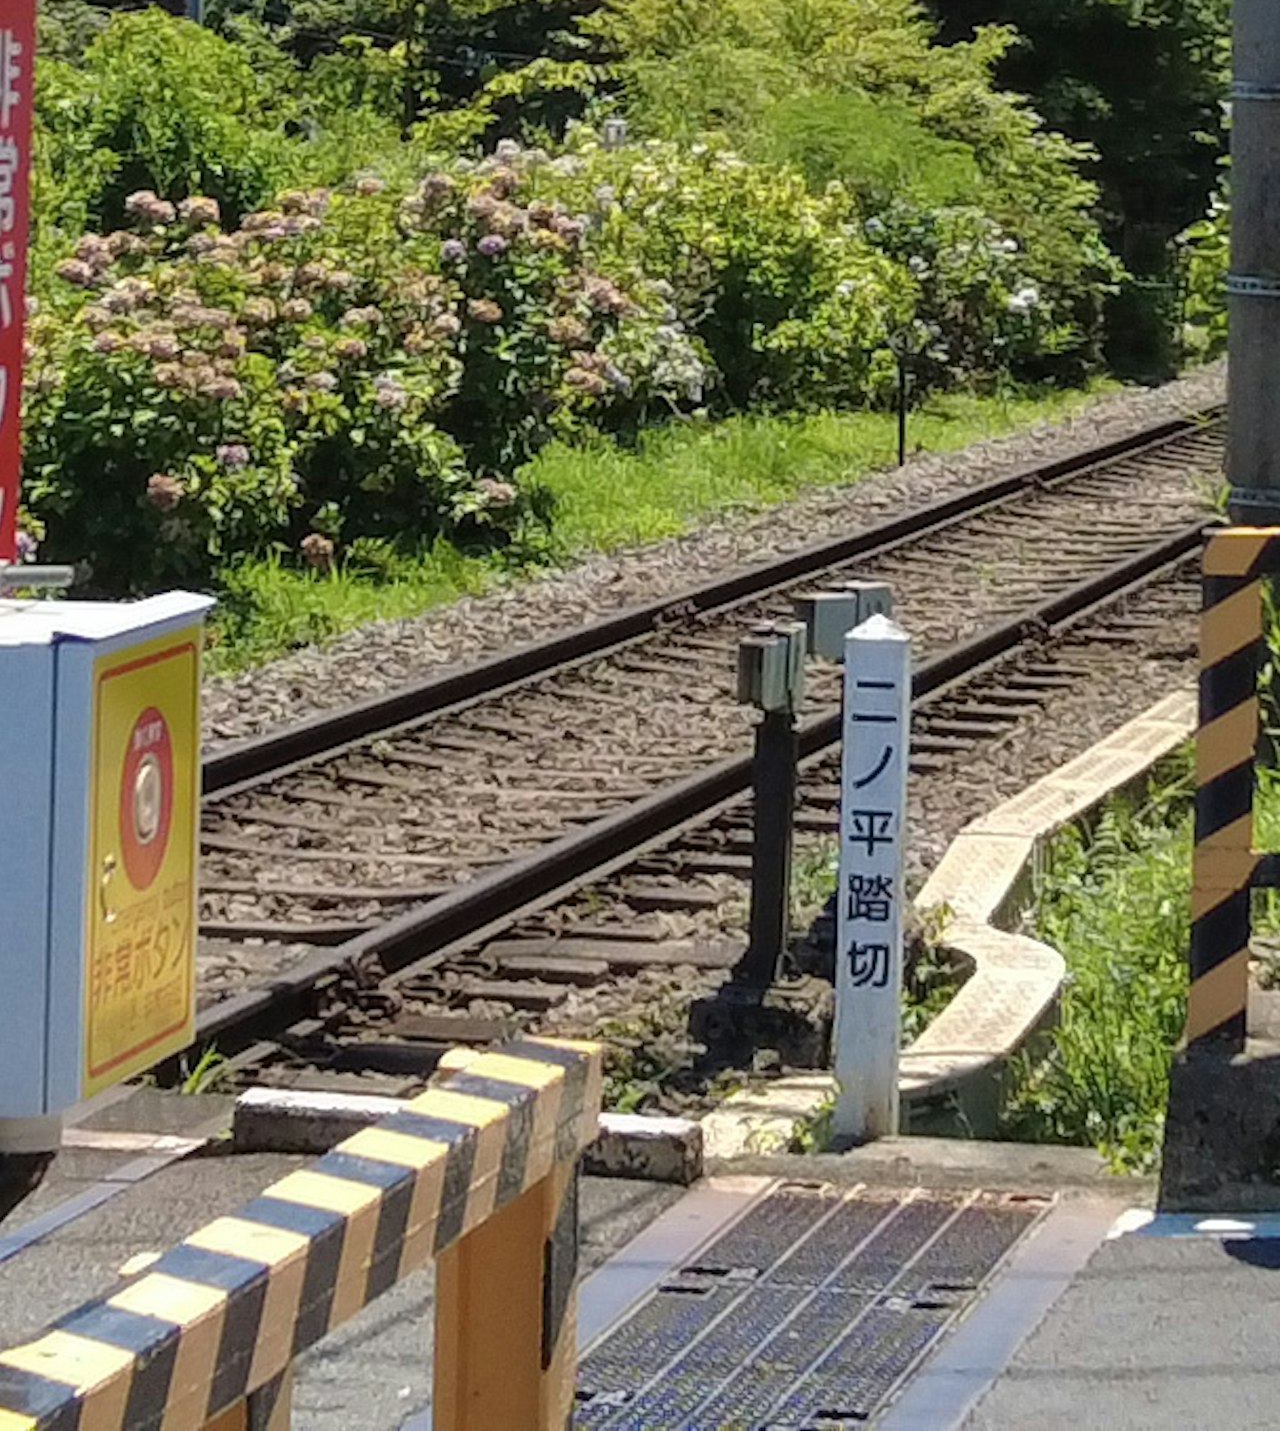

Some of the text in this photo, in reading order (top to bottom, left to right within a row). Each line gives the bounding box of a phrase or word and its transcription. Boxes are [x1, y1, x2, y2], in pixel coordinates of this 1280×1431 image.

[846, 680, 898, 988] 二ノ平踏切
[93, 916, 188, 1008] 非常ボタン
